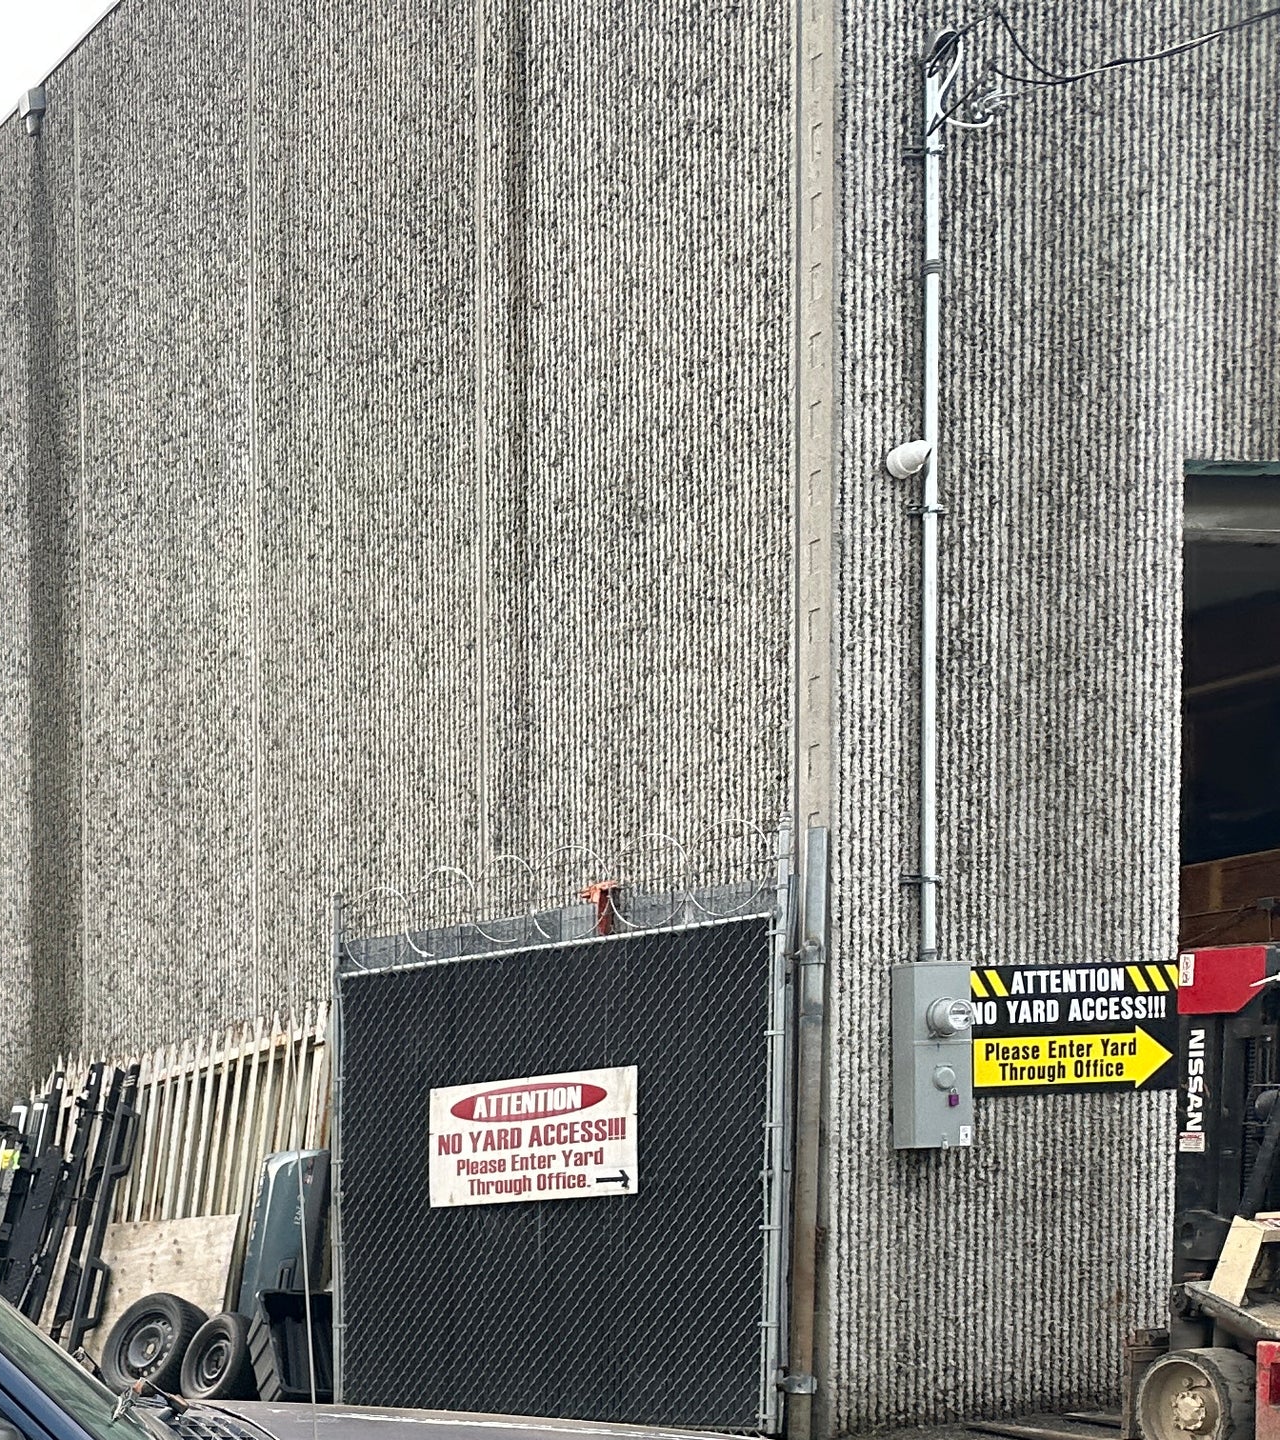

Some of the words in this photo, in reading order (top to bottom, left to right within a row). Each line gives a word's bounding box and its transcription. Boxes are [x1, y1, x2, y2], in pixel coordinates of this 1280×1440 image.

[1010, 968, 1125, 995] ATTENTION
[970, 1000, 997, 1025] NO
[1005, 999, 1059, 1024] YARD
[1068, 995, 1166, 1022] ACCESS!!!
[984, 1042, 1040, 1061] Please
[1048, 1040, 1093, 1060] Enter
[1100, 1037, 1137, 1057] Yard
[998, 1061, 1066, 1082] Through
[1074, 1059, 1124, 1078] Office
[1187, 1028, 1206, 1132] NISSAN
[472, 1085, 583, 1119] ATTENTION
[437, 1133, 463, 1155] NO
[468, 1127, 522, 1152] YARD
[528, 1117, 627, 1147] ACCESS!!!
[456, 1156, 507, 1176] Please
[511, 1154, 557, 1172] Enter
[561, 1147, 604, 1168] Yard
[467, 1174, 532, 1196] Through
[536, 1172, 592, 1191] Office.
